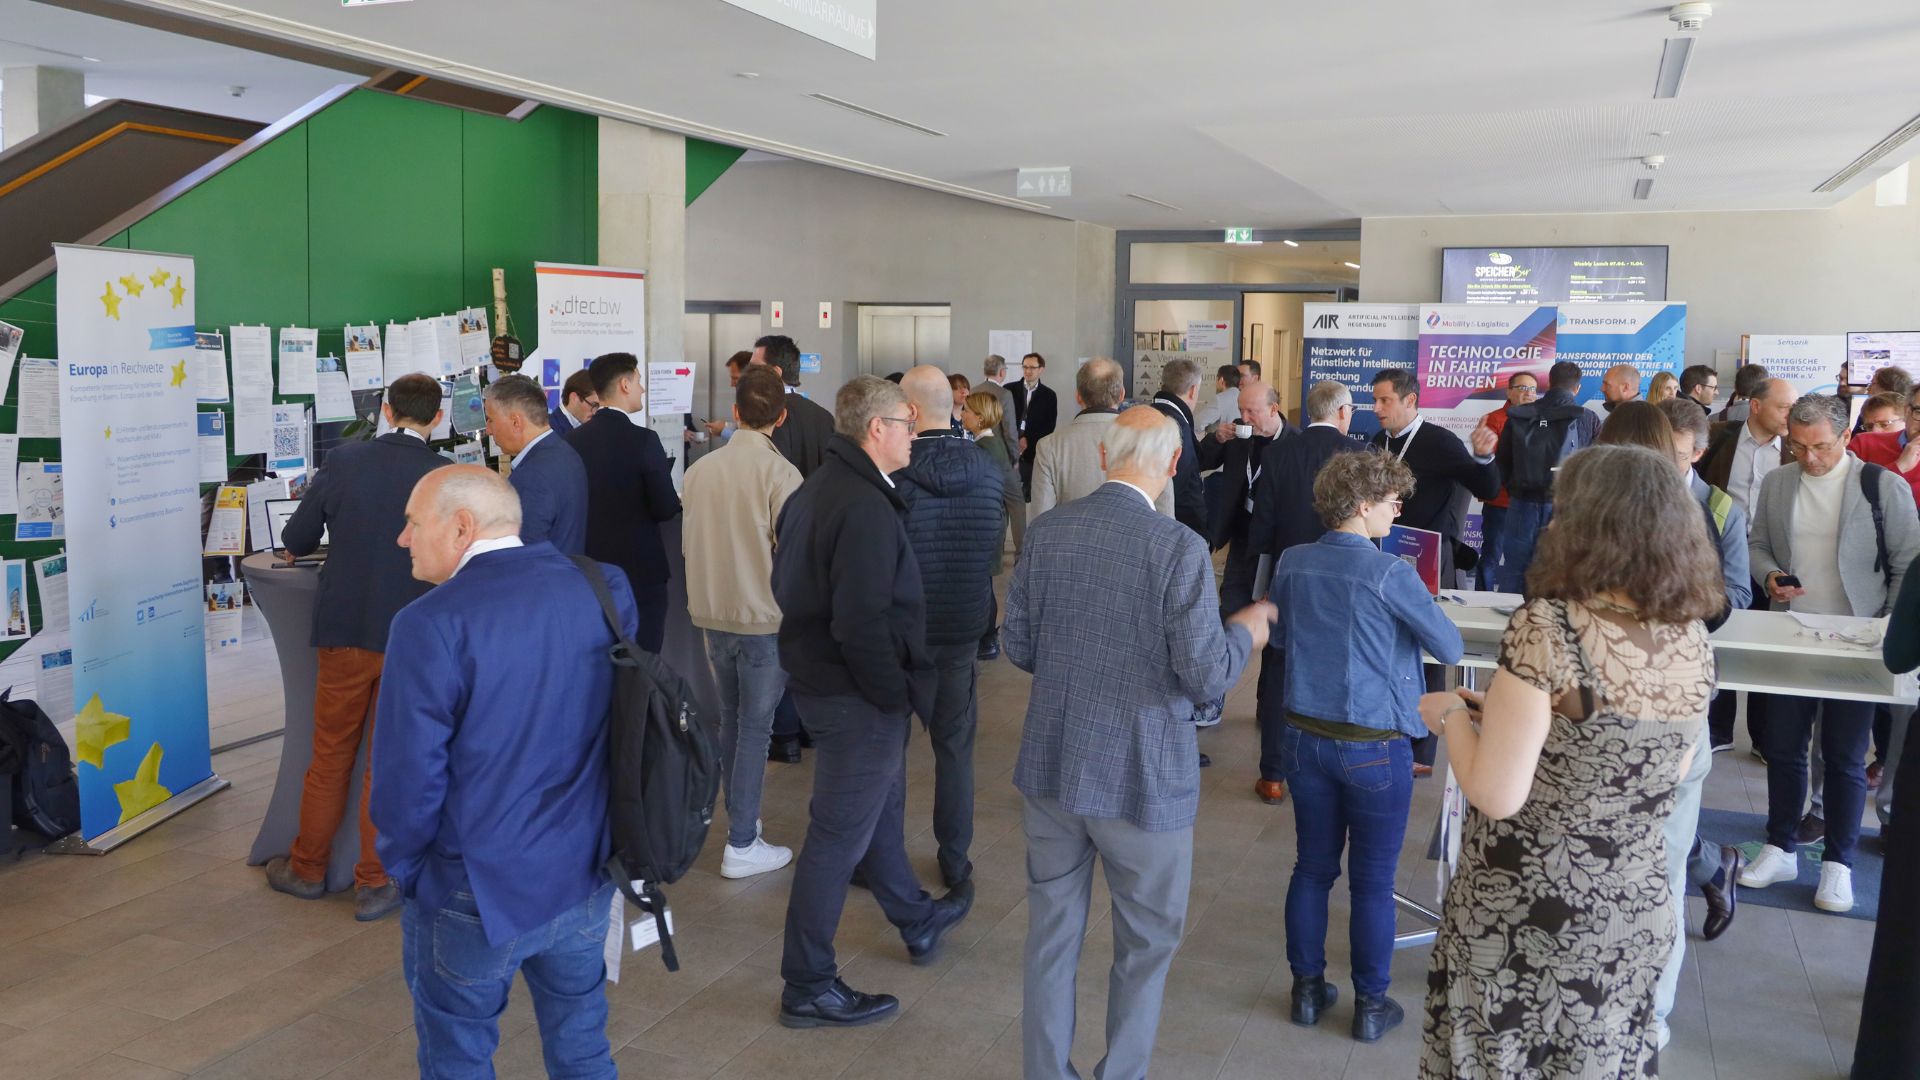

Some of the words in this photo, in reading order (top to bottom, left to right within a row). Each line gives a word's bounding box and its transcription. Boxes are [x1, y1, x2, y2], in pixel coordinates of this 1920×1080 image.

[1312, 314, 1339, 329] AIR
[1442, 320, 1470, 328] Mobility
[1777, 338, 1809, 346] Sensorik
[1311, 347, 1356, 356] Netzwerk
[1358, 347, 1372, 357] für
[1429, 345, 1543, 359] TECHNOLOGIE
[1556, 352, 1633, 360] RANSFORMATION
[69, 363, 108, 378] Europa
[110, 364, 119, 375] in
[121, 362, 164, 375] Reichweite
[1310, 357, 1360, 367] Künstliche
[1363, 359, 1416, 370] Intelligenz:
[1428, 360, 1446, 372] IN
[1449, 361, 1502, 373] FAHRT
[1310, 371, 1360, 383] Forschung
[1426, 375, 1497, 388] BRINGEN
